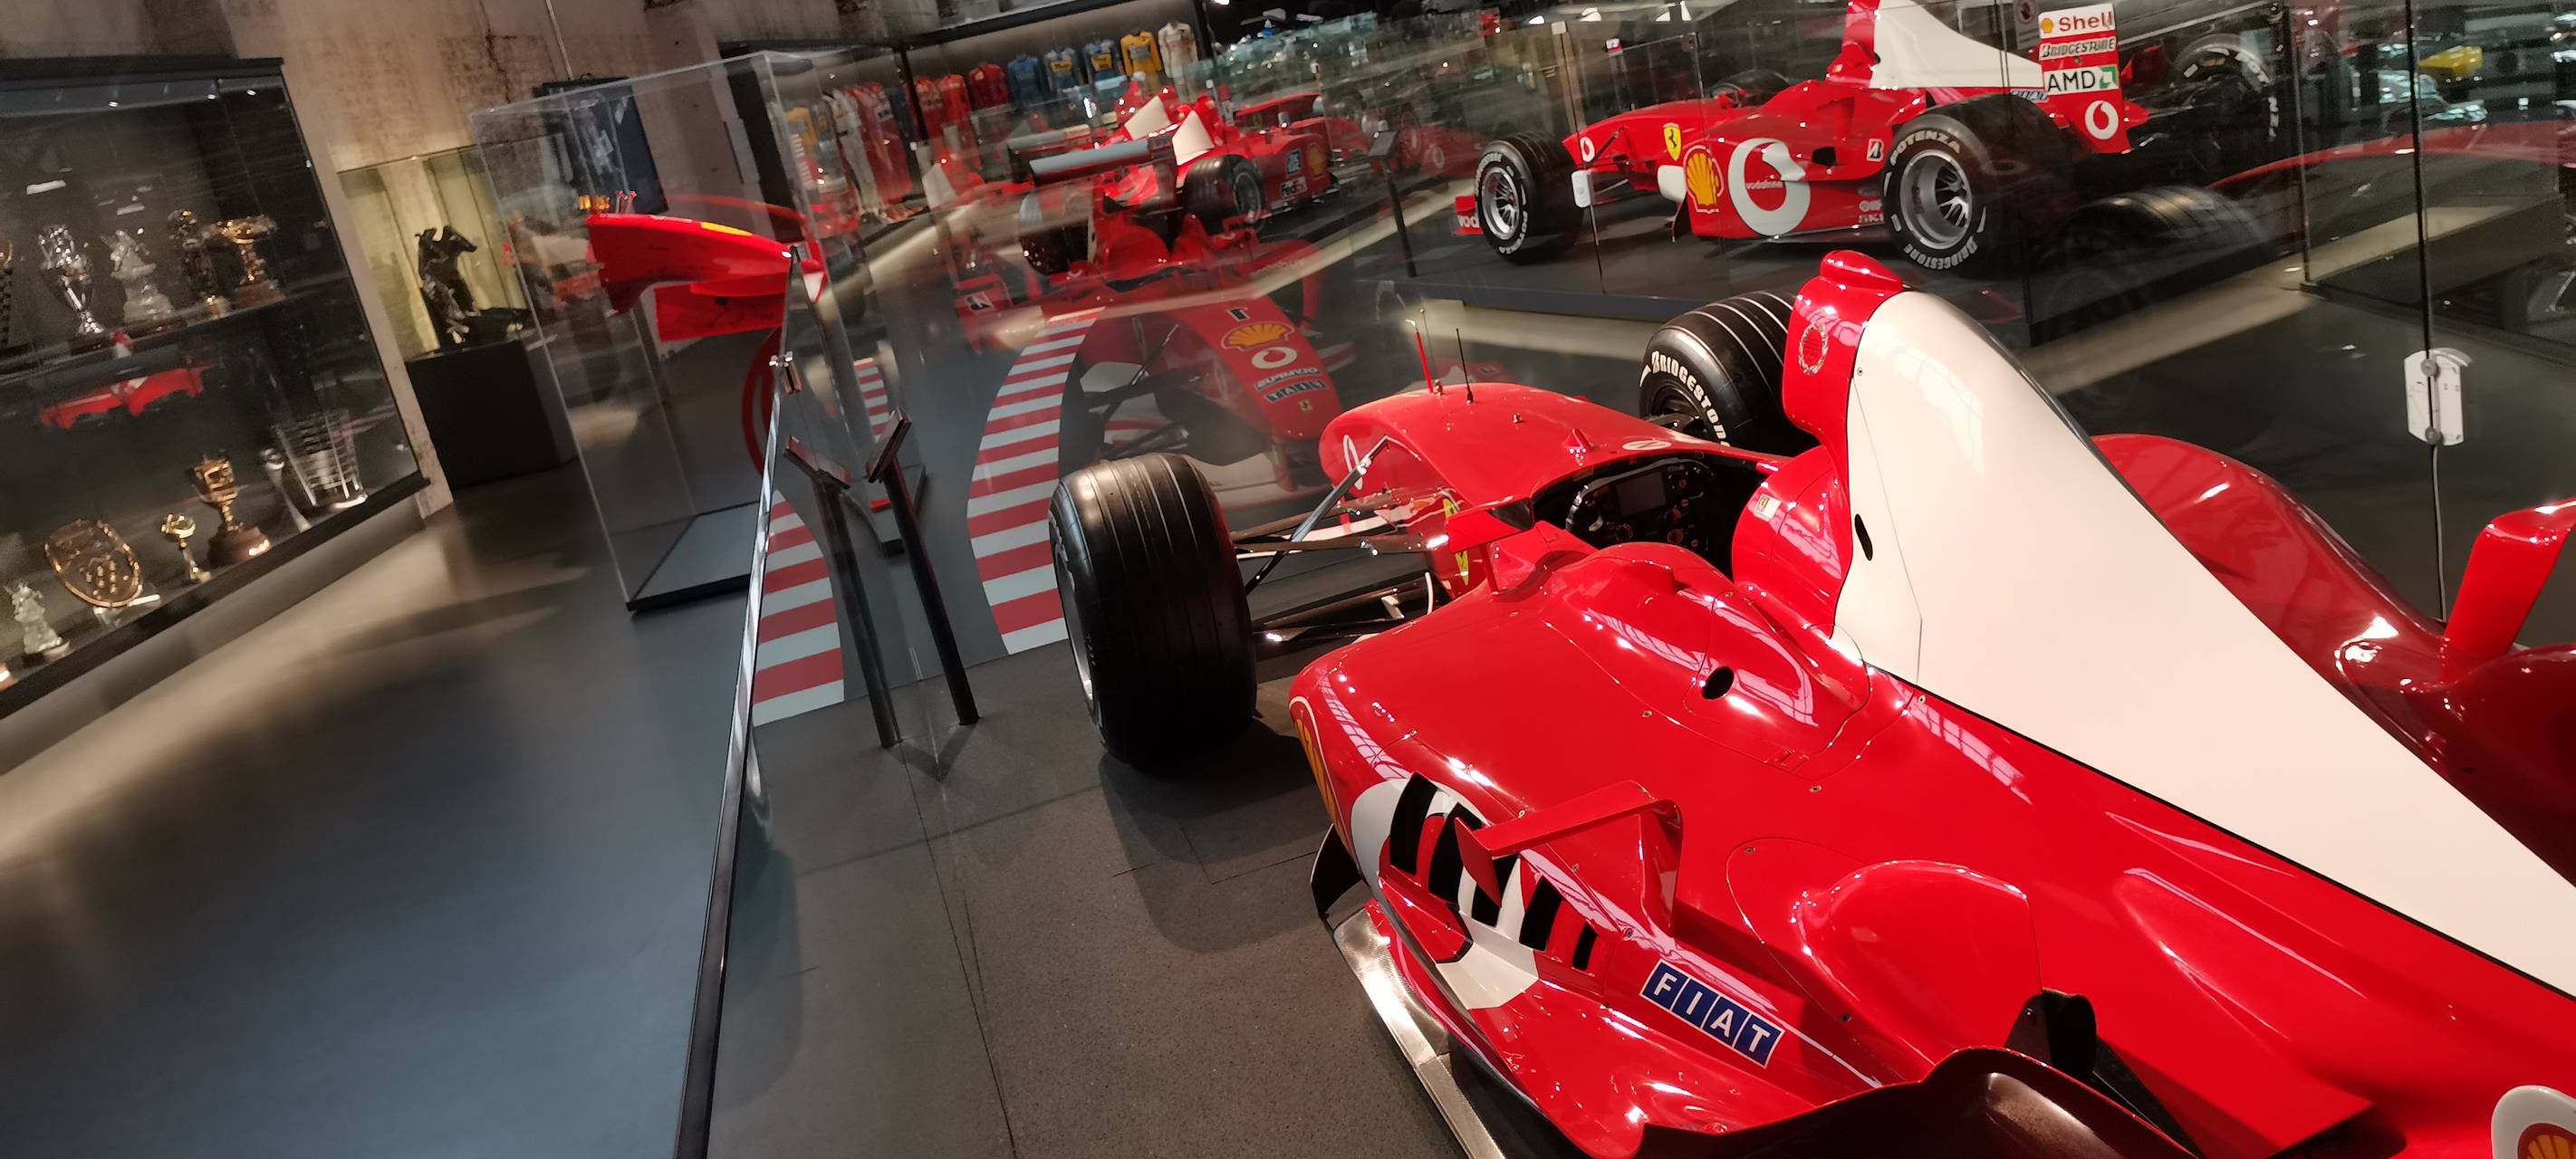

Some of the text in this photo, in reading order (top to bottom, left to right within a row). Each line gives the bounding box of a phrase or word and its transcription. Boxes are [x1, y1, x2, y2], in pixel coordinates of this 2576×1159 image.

[2058, 11, 2113, 32] Shell
[2042, 38, 2116, 58] BRIDGESTONE
[2048, 70, 2096, 91] AMD
[1890, 130, 1961, 167] POTENZA
[1903, 235, 1978, 270] BRIDGESTONE
[1653, 972, 1772, 1053] FIAT
